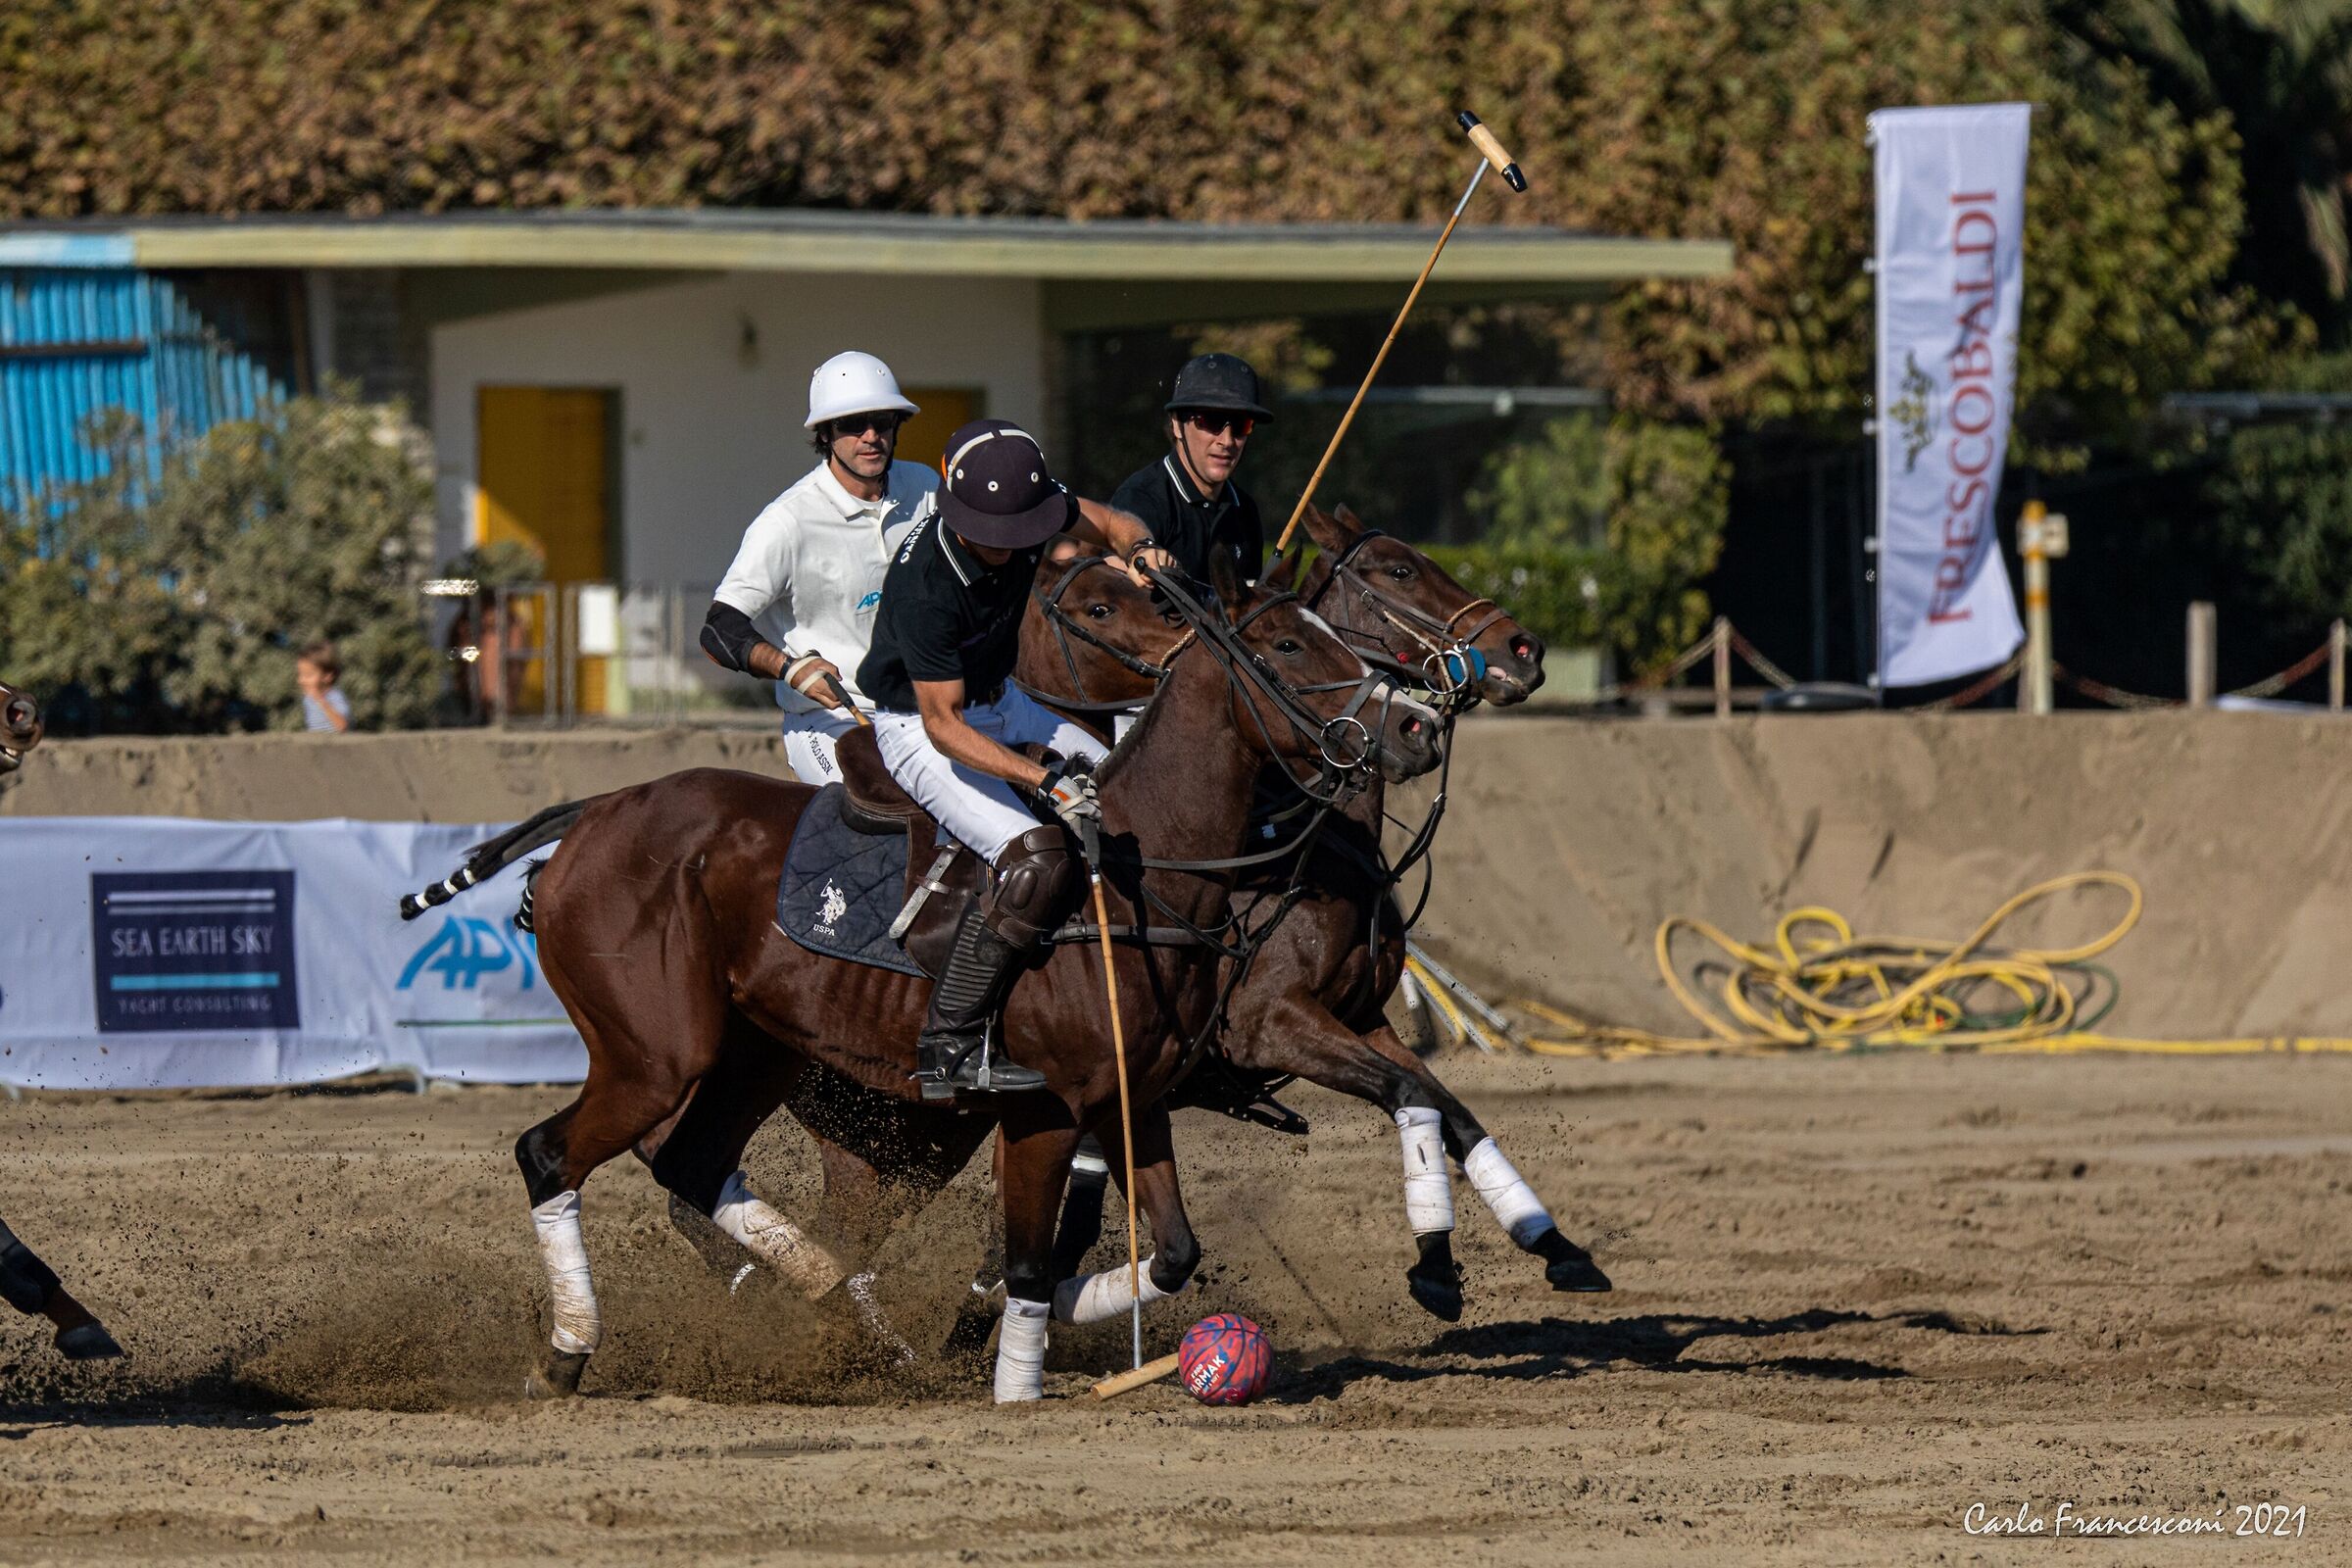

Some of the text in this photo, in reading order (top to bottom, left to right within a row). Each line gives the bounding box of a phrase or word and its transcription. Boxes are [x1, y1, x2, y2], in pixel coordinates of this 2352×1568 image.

[1929, 189, 1997, 624] FRESCOBALDI
[809, 736, 822, 757] POLO
[111, 924, 274, 957] SEA EARTH SKY
[812, 923, 836, 937] USPA
[119, 993, 273, 1014] YACHT CONSULTING
[1189, 1353, 1226, 1396] TARMAK
